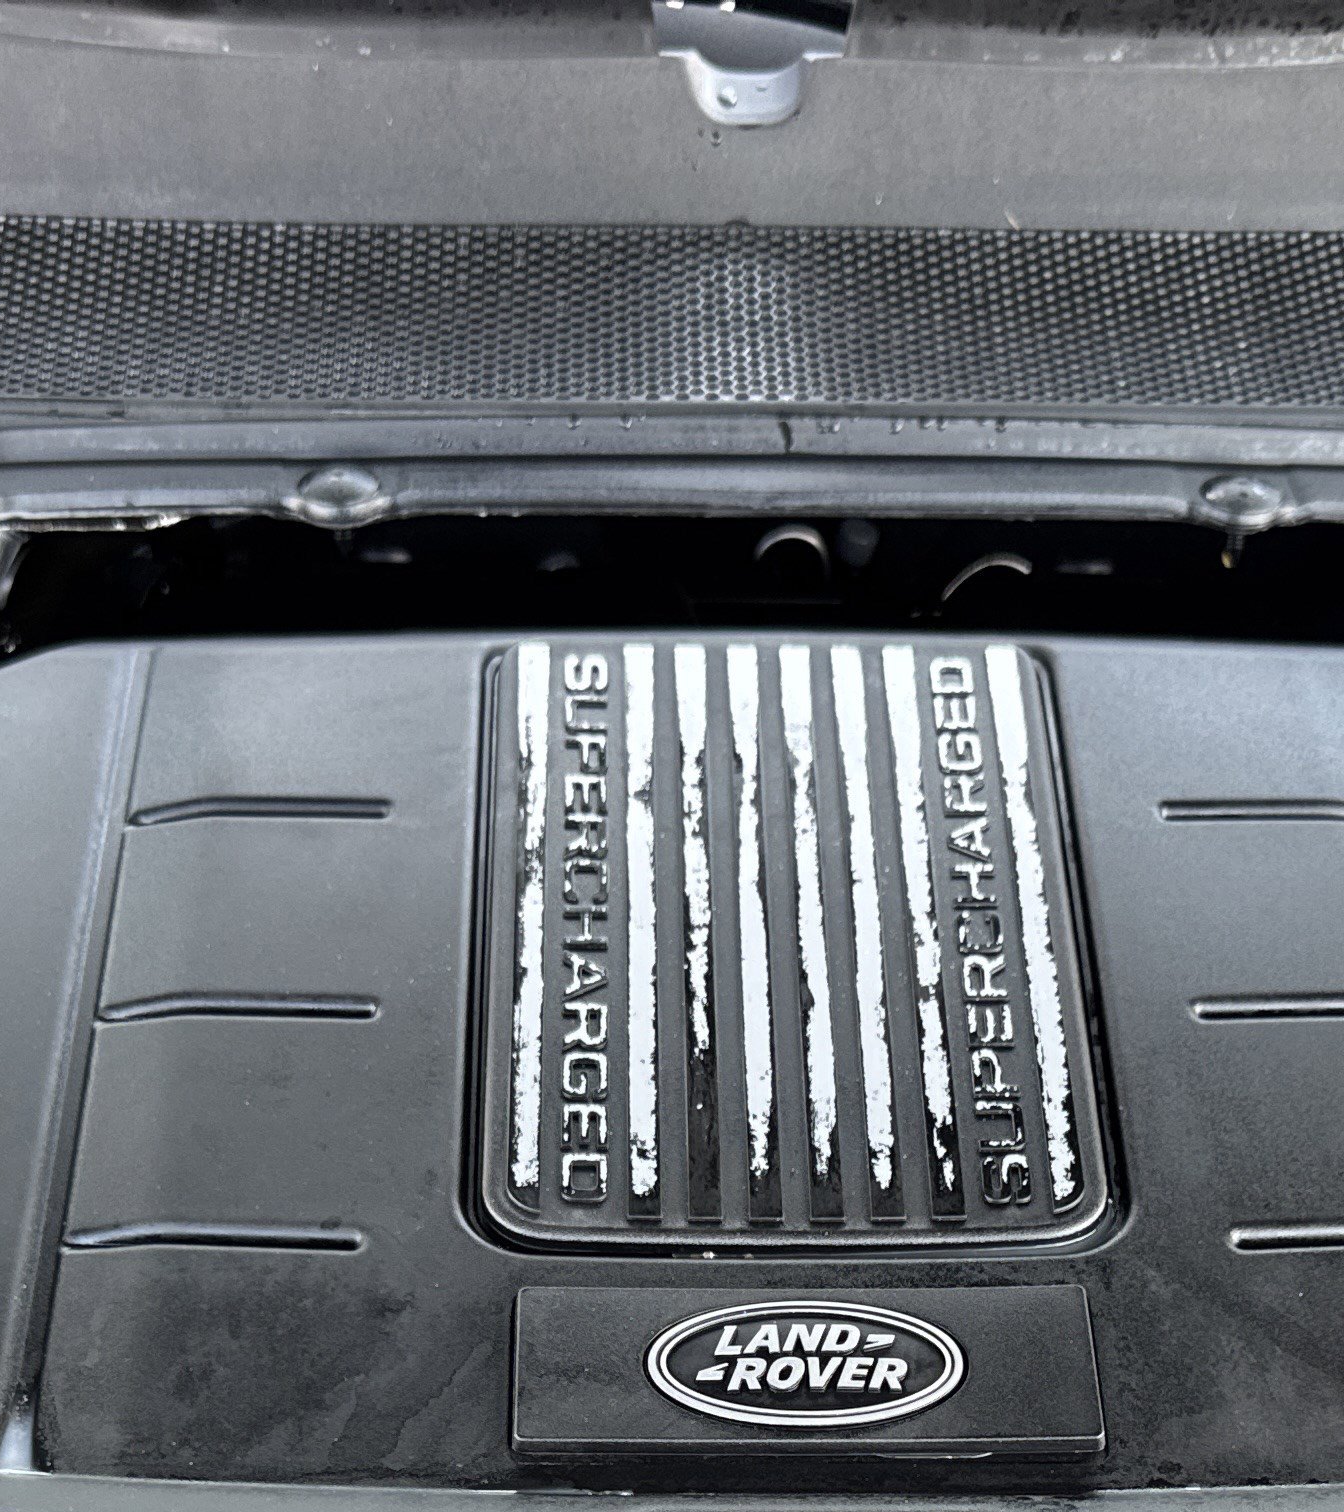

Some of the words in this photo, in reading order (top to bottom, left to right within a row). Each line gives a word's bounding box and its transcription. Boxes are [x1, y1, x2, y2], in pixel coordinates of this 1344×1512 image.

[559, 652, 609, 1204] SUPERCHARGED
[929, 655, 1033, 1207] SUPERCHARGED
[713, 1323, 862, 1356] LAND
[726, 1356, 908, 1393] ROVER
